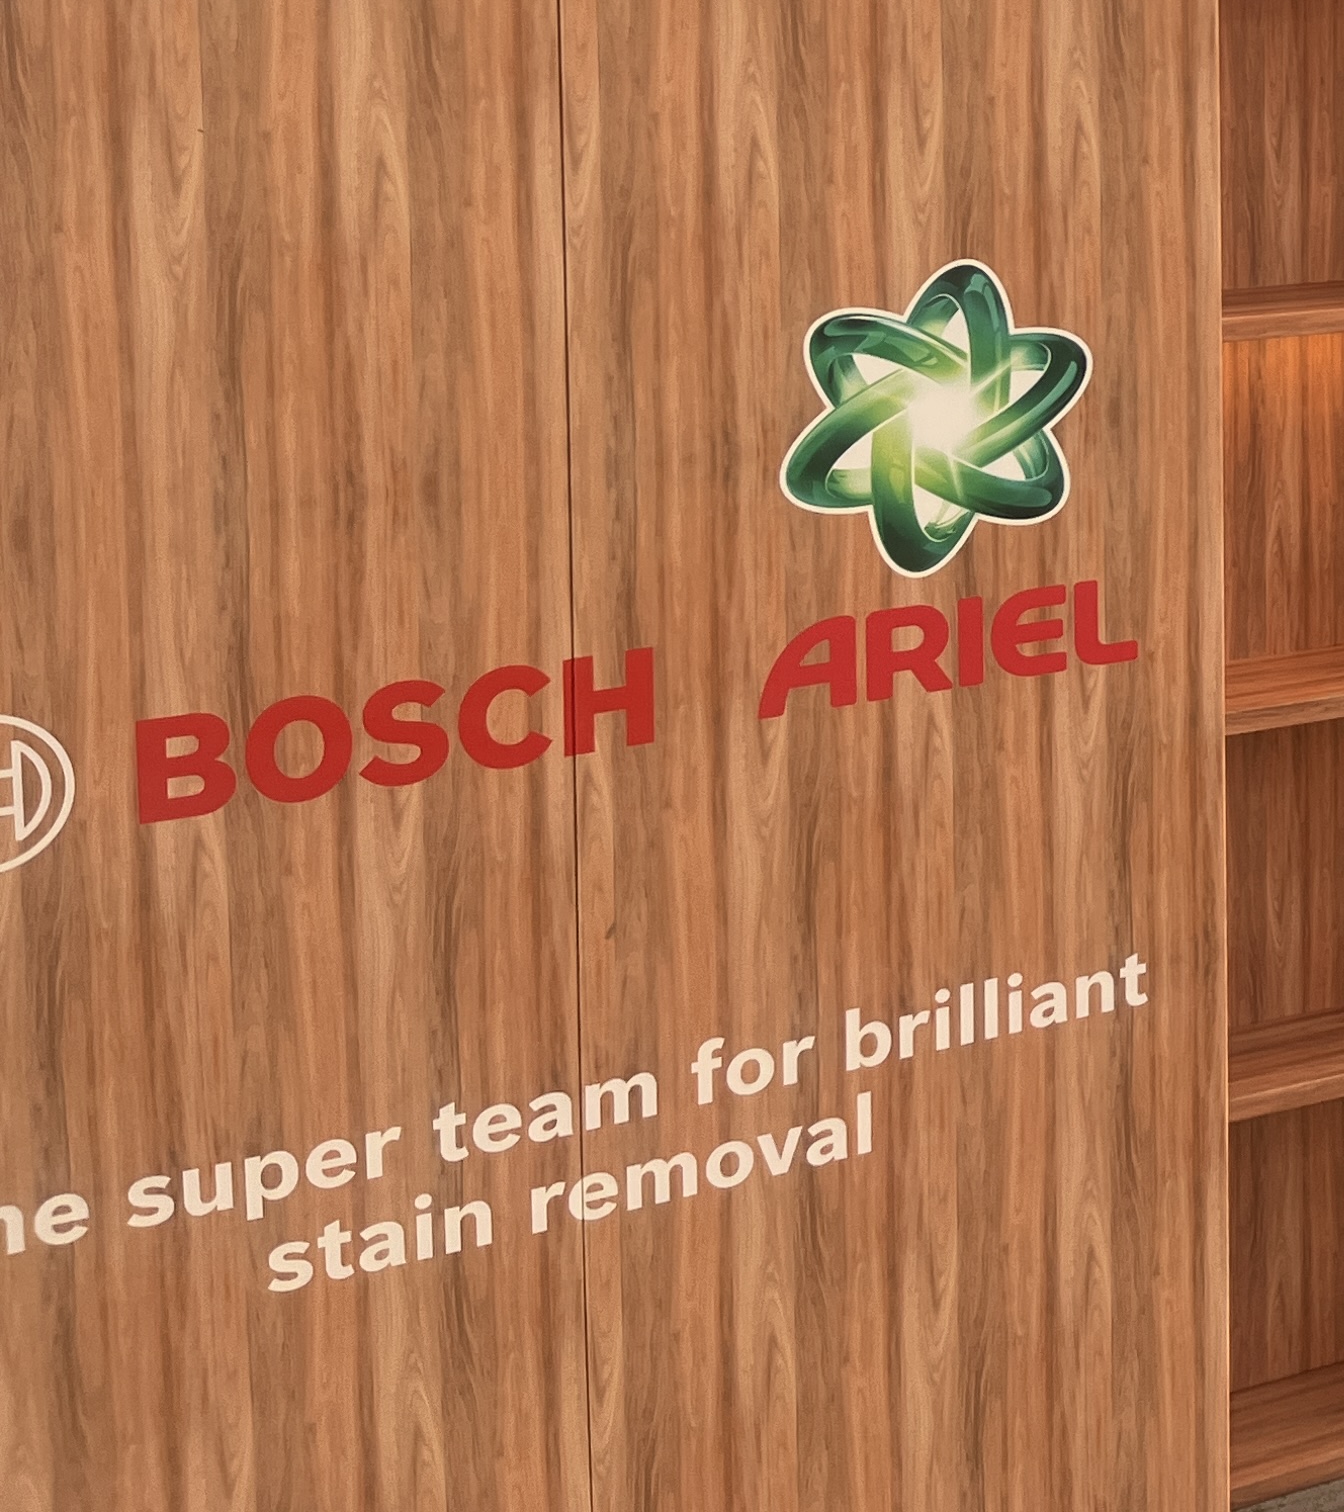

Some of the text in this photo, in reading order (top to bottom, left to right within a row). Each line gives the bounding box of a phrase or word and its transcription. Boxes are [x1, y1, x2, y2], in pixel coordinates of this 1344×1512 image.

[134, 644, 655, 825] BOSCH
[757, 580, 1139, 720] ARIEL
[127, 1125, 402, 1228] super
[432, 1072, 658, 1162] team
[690, 1035, 816, 1106] for
[844, 953, 1148, 1072] brilliant
[267, 1092, 872, 1292] stain removal
